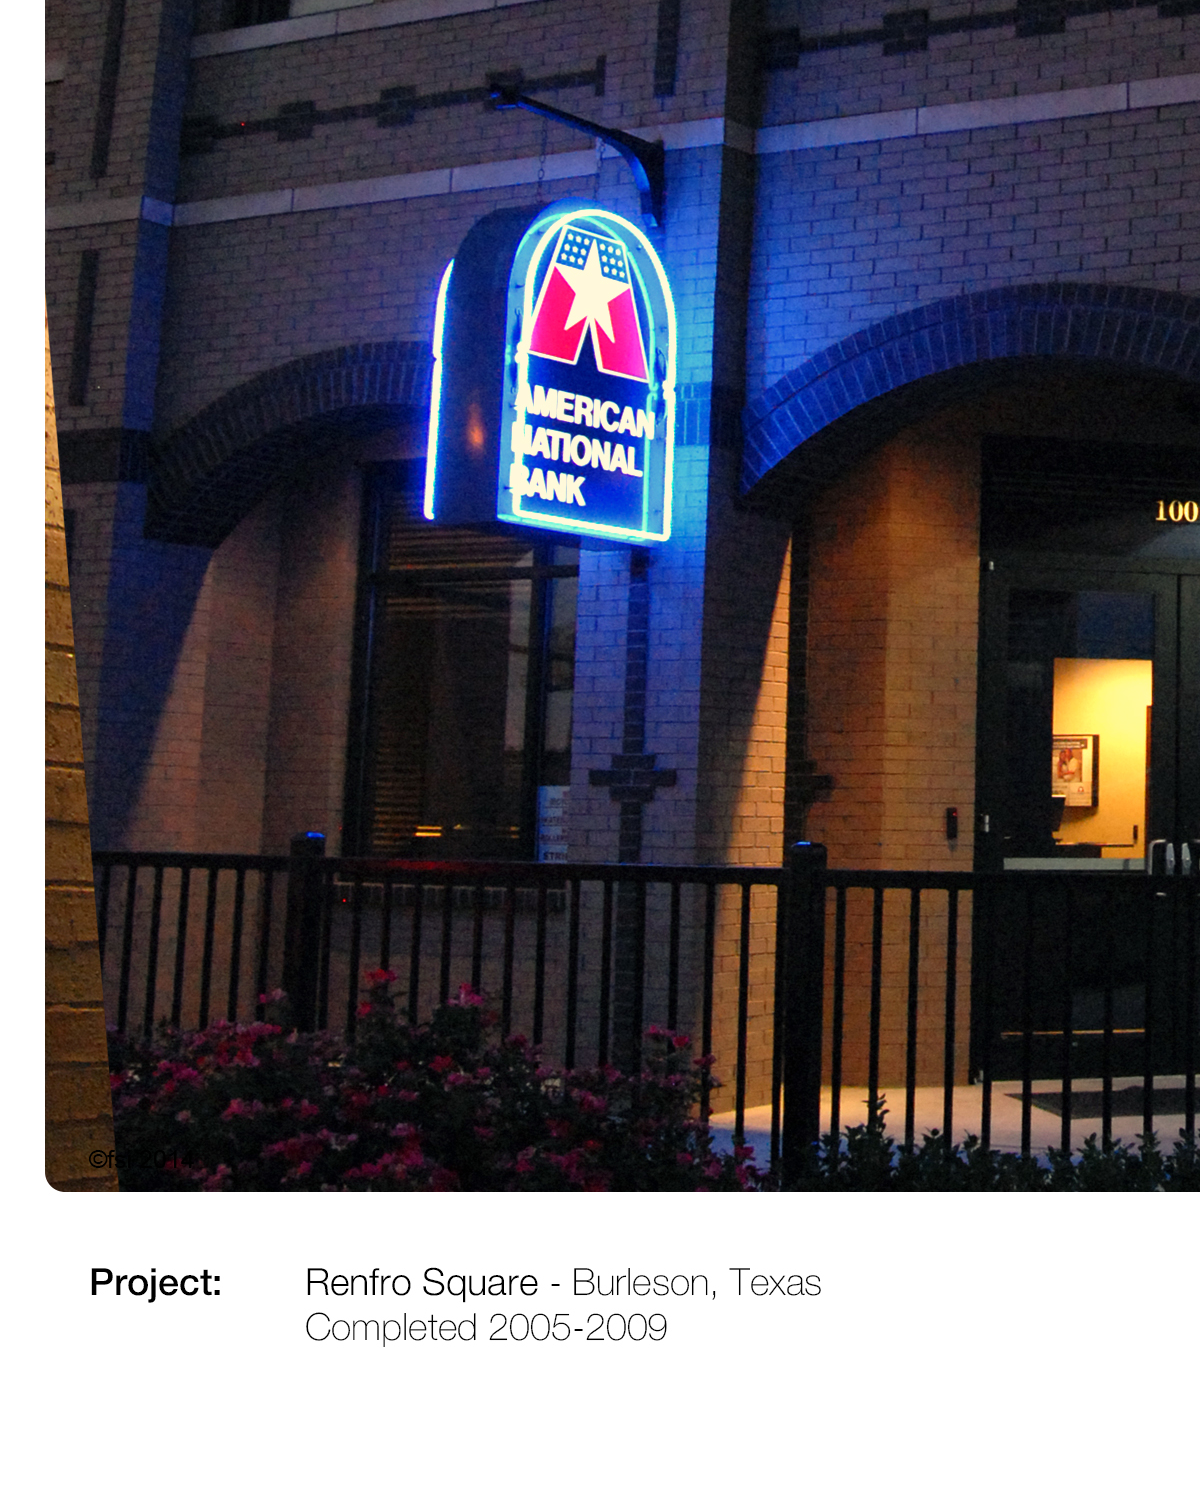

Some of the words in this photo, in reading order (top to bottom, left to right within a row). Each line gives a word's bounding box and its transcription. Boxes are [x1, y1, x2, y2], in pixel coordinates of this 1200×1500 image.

[513, 382, 655, 440] AMERICAN
[511, 421, 644, 477] NATIONAL
[509, 462, 587, 507] BANK
[1155, 500, 1200, 523] 100
